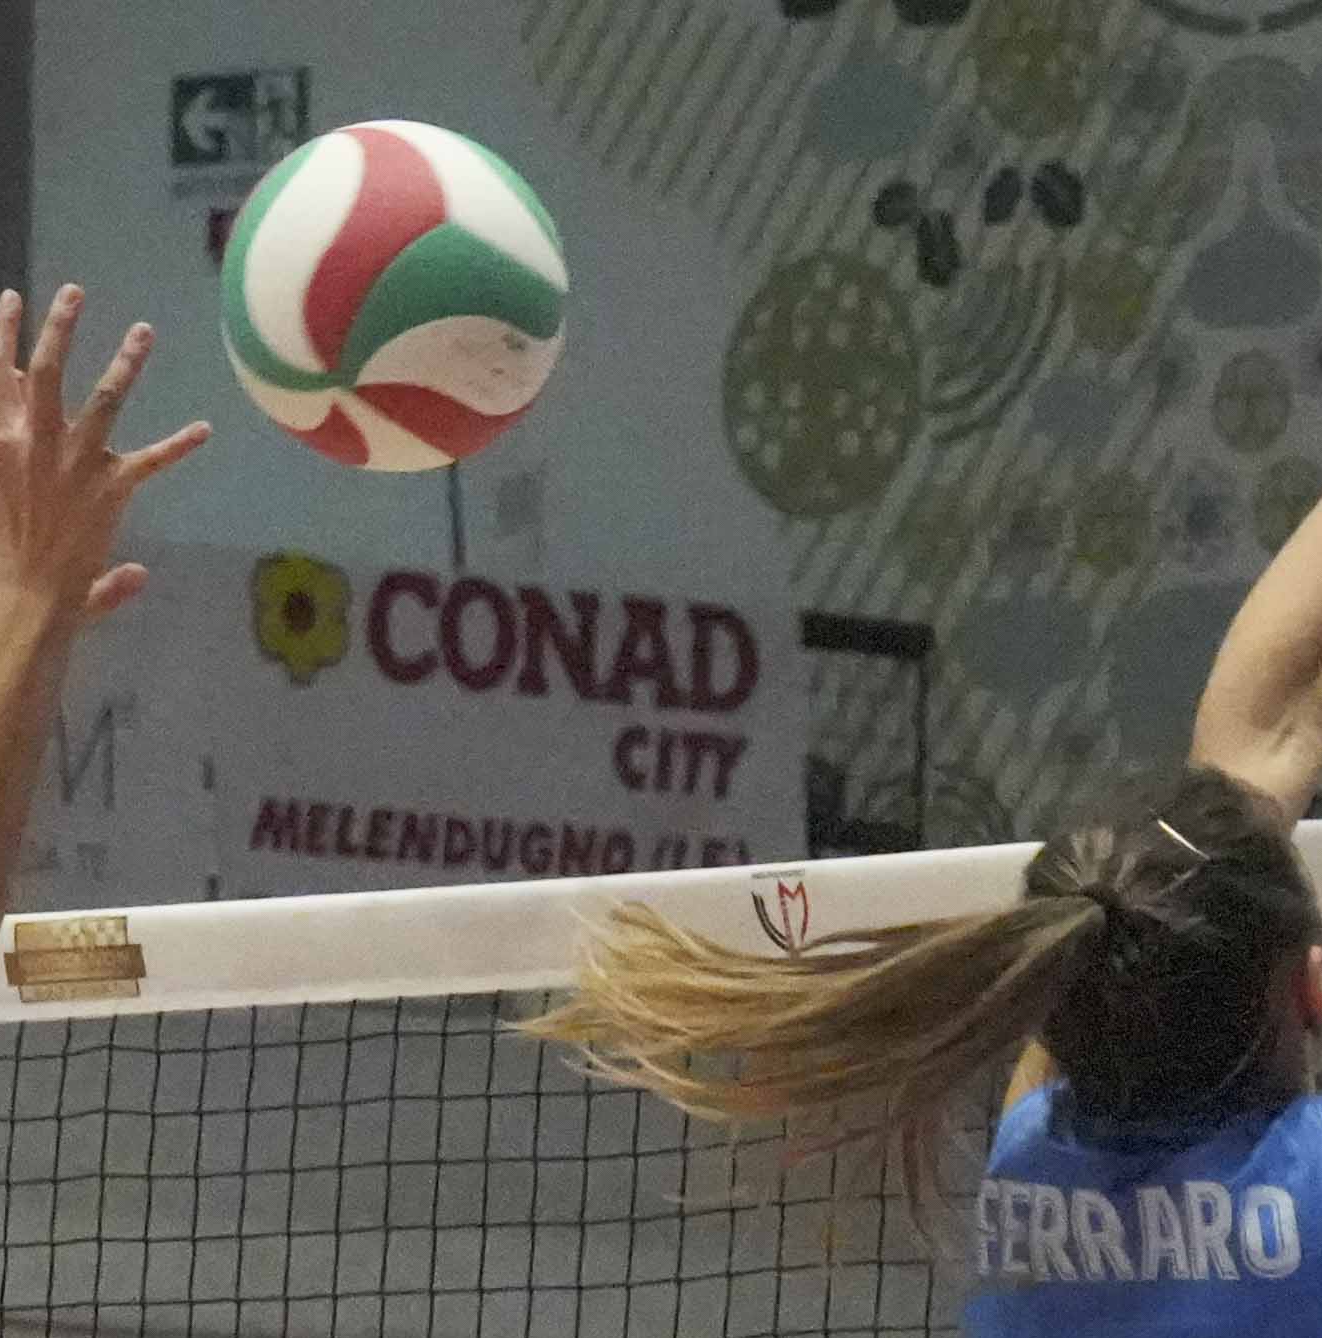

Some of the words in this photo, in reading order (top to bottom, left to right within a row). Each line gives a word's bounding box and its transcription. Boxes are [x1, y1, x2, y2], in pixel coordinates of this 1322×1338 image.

[367, 570, 760, 710] CONAD
[612, 725, 749, 800] CITY
[250, 800, 636, 874] MELENDUGNO
[976, 1179, 1302, 1280] FERRARO
